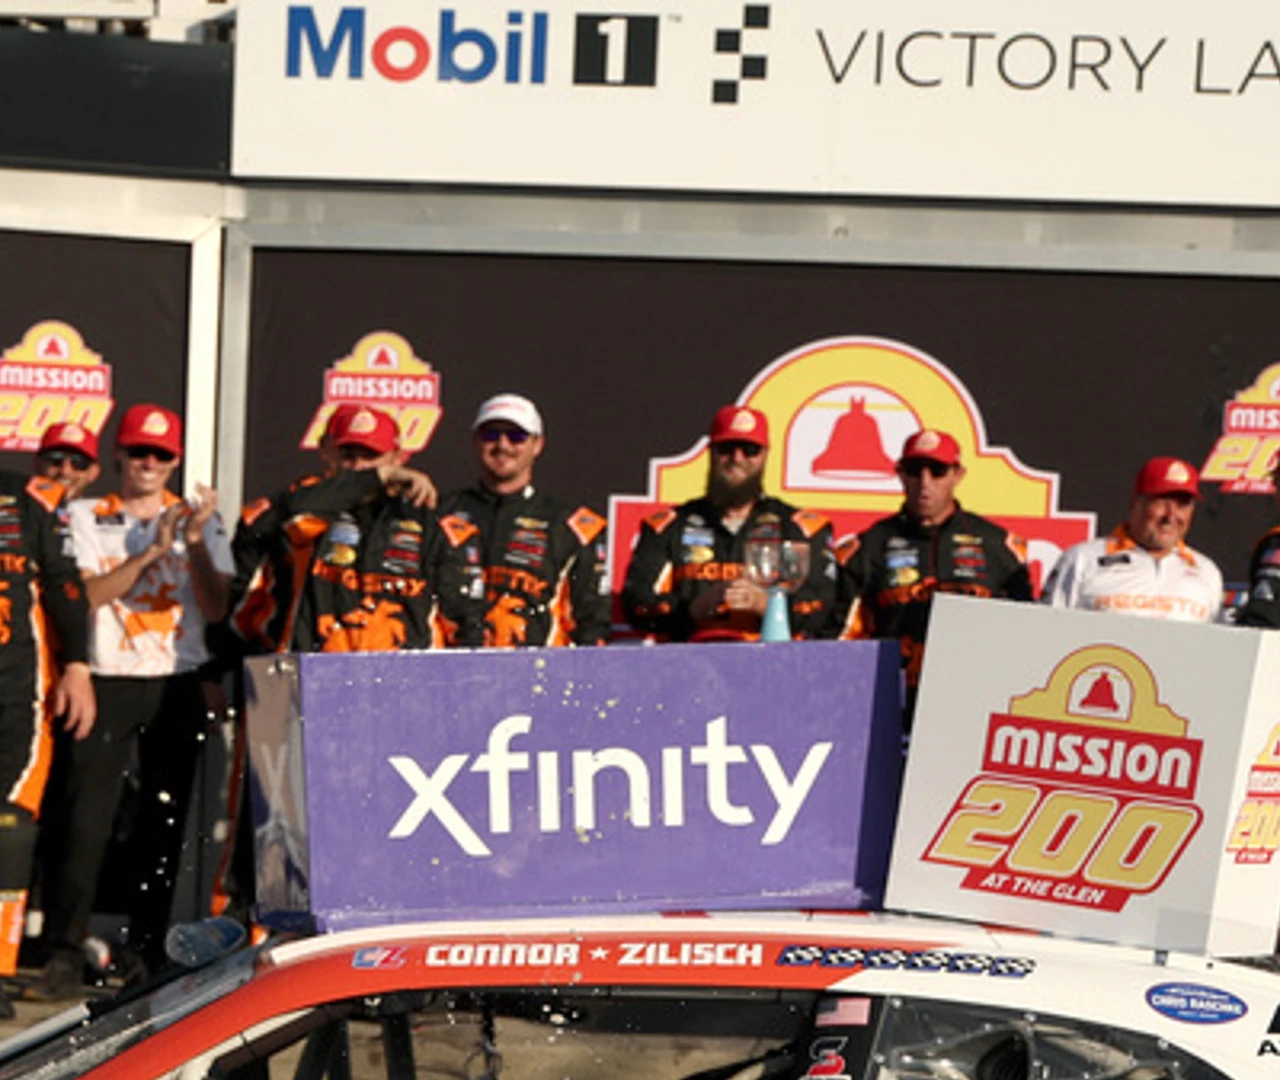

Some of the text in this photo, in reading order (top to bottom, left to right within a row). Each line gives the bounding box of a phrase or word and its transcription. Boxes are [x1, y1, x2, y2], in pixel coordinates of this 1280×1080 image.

[284, 4, 644, 84] Mobil 1
[814, 27, 1171, 94] VICTORY
[385, 713, 837, 857] xfinity
[927, 780, 1199, 890] 200
[980, 872, 1107, 905] AT THE GLEN
[425, 943, 763, 967] CONNOR ZILISCH
